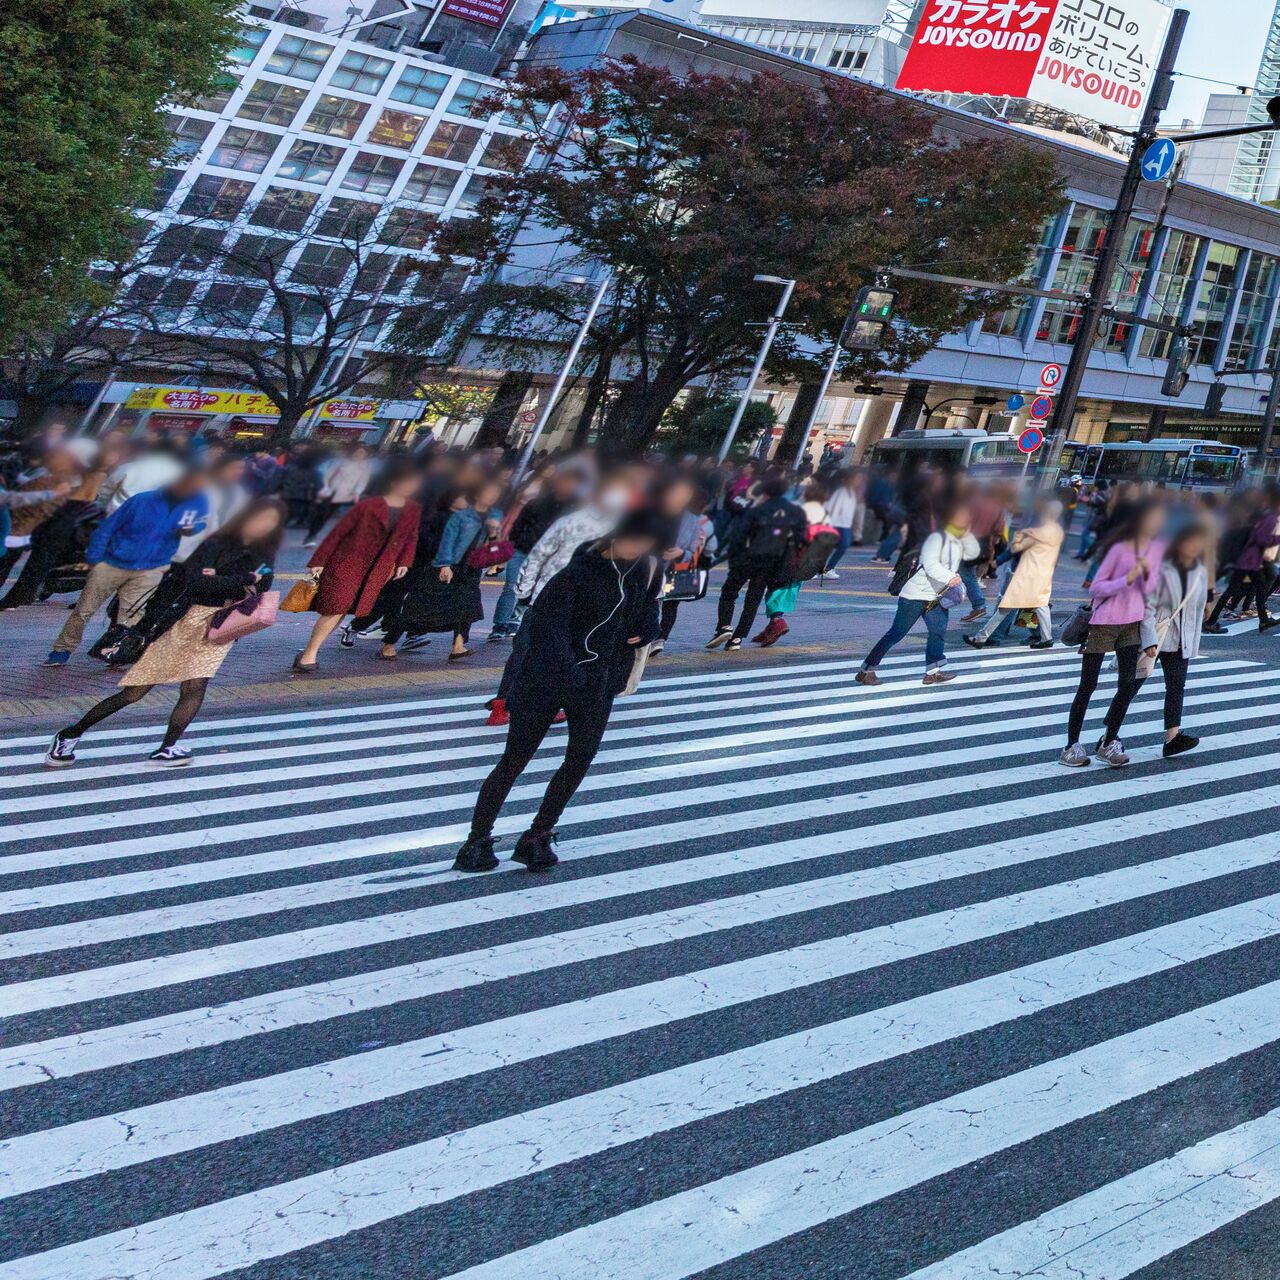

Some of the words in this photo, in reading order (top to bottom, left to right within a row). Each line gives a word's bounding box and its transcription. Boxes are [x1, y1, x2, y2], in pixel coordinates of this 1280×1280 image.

[918, 25, 1042, 52] JOYSOUND
[1054, 13, 1150, 69] ボリューム、
[1048, 36, 1147, 88] あげていこう。
[1036, 56, 1143, 110] JOYSOUND
[164, 391, 217, 403] 大当たりの
[327, 400, 373, 411] 大当たりの
[179, 509, 199, 526] H
